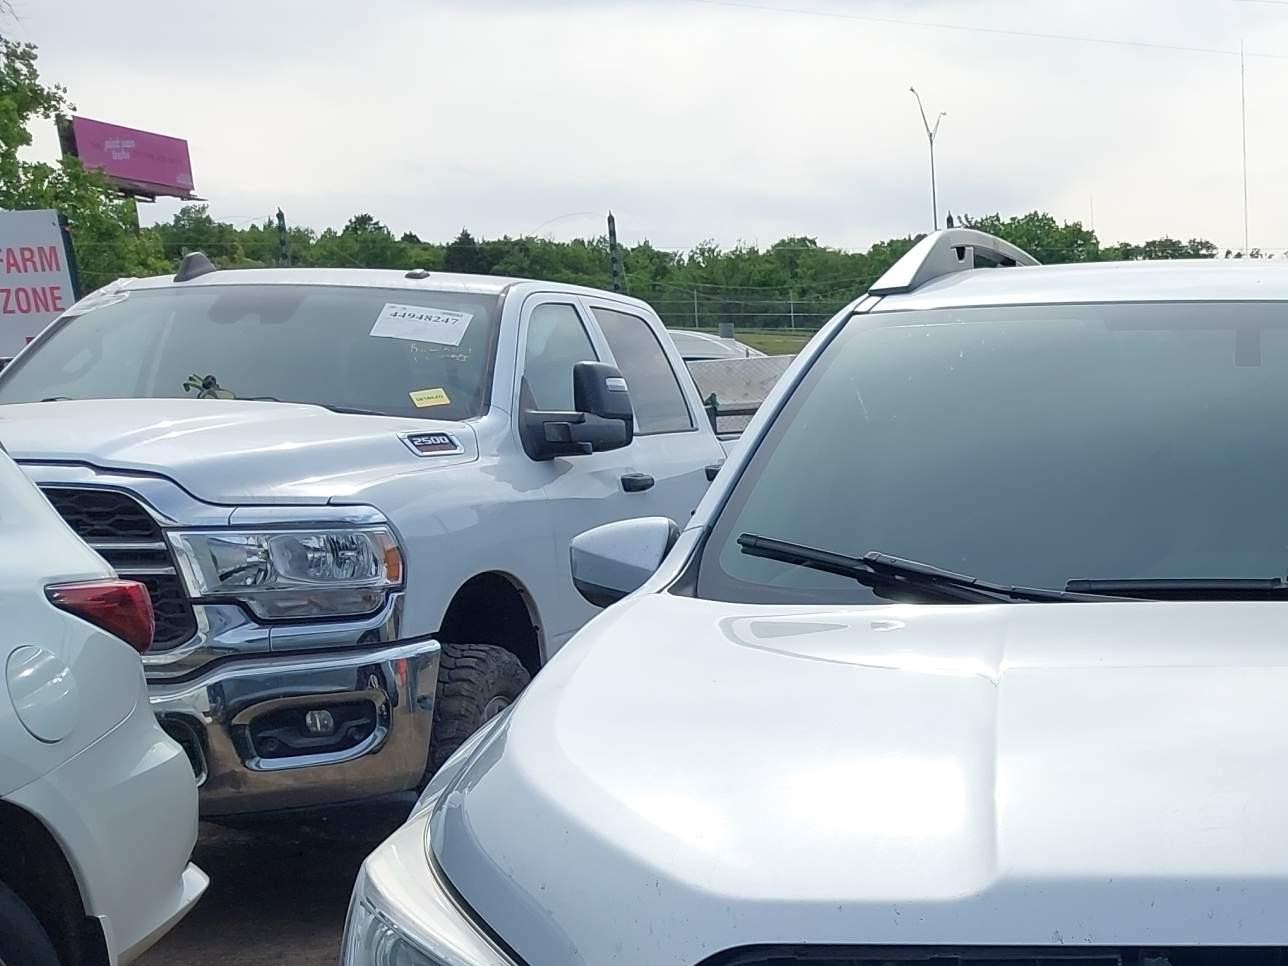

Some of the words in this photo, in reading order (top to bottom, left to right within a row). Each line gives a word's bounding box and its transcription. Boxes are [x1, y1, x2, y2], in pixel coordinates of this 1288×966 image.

[0, 246, 61, 274] ARM
[0, 286, 65, 315] ZONE
[390, 311, 459, 325] 44948247
[411, 435, 450, 446] 2500
